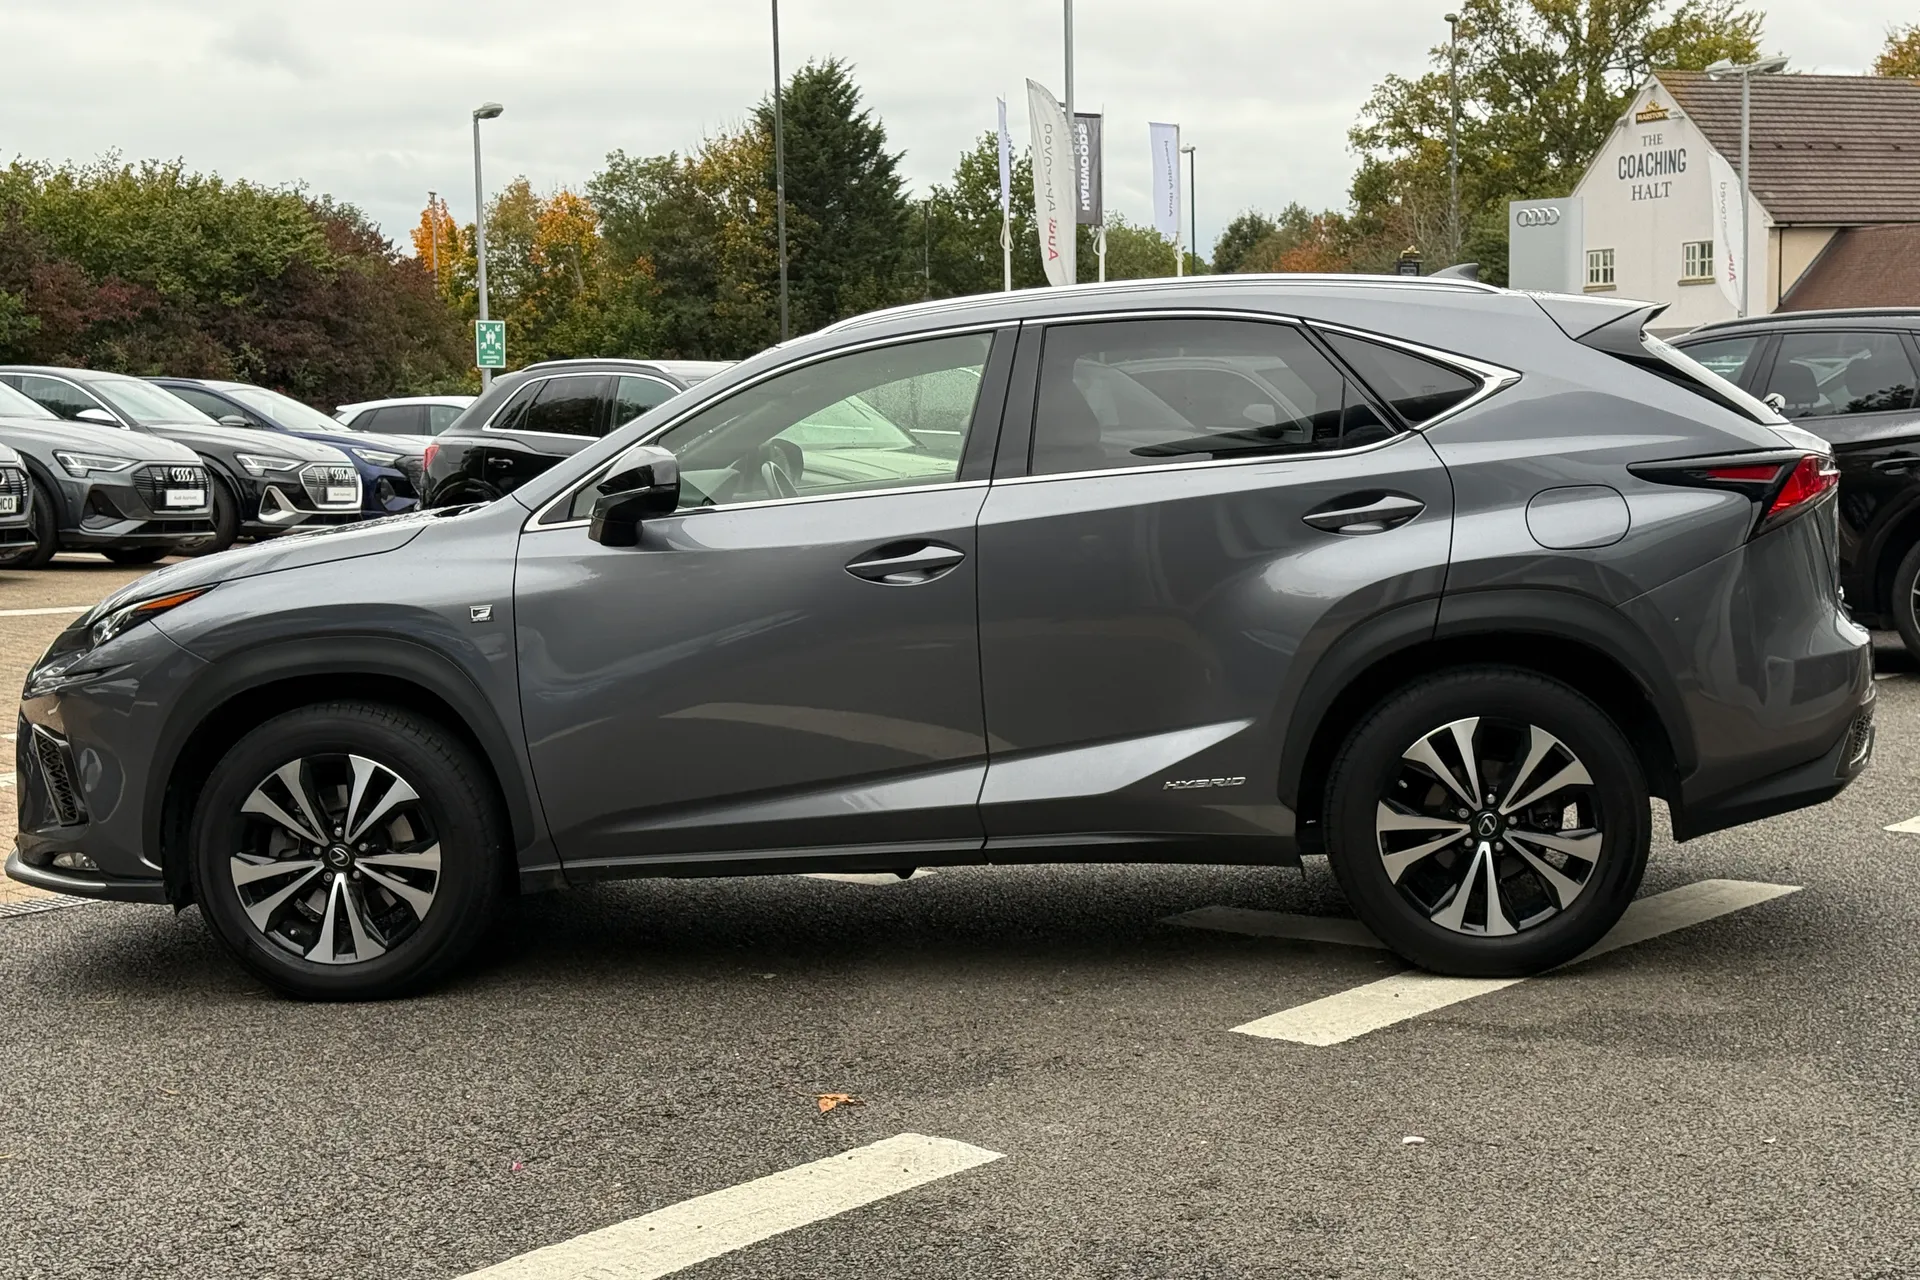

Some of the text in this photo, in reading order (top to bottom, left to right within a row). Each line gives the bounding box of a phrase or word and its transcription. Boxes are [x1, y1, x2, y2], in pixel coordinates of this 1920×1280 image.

[1642, 133, 1663, 147] THE
[1618, 148, 1687, 180] COACHING
[1631, 181, 1673, 201] HALT
[1163, 776, 1246, 790] HYBRID
